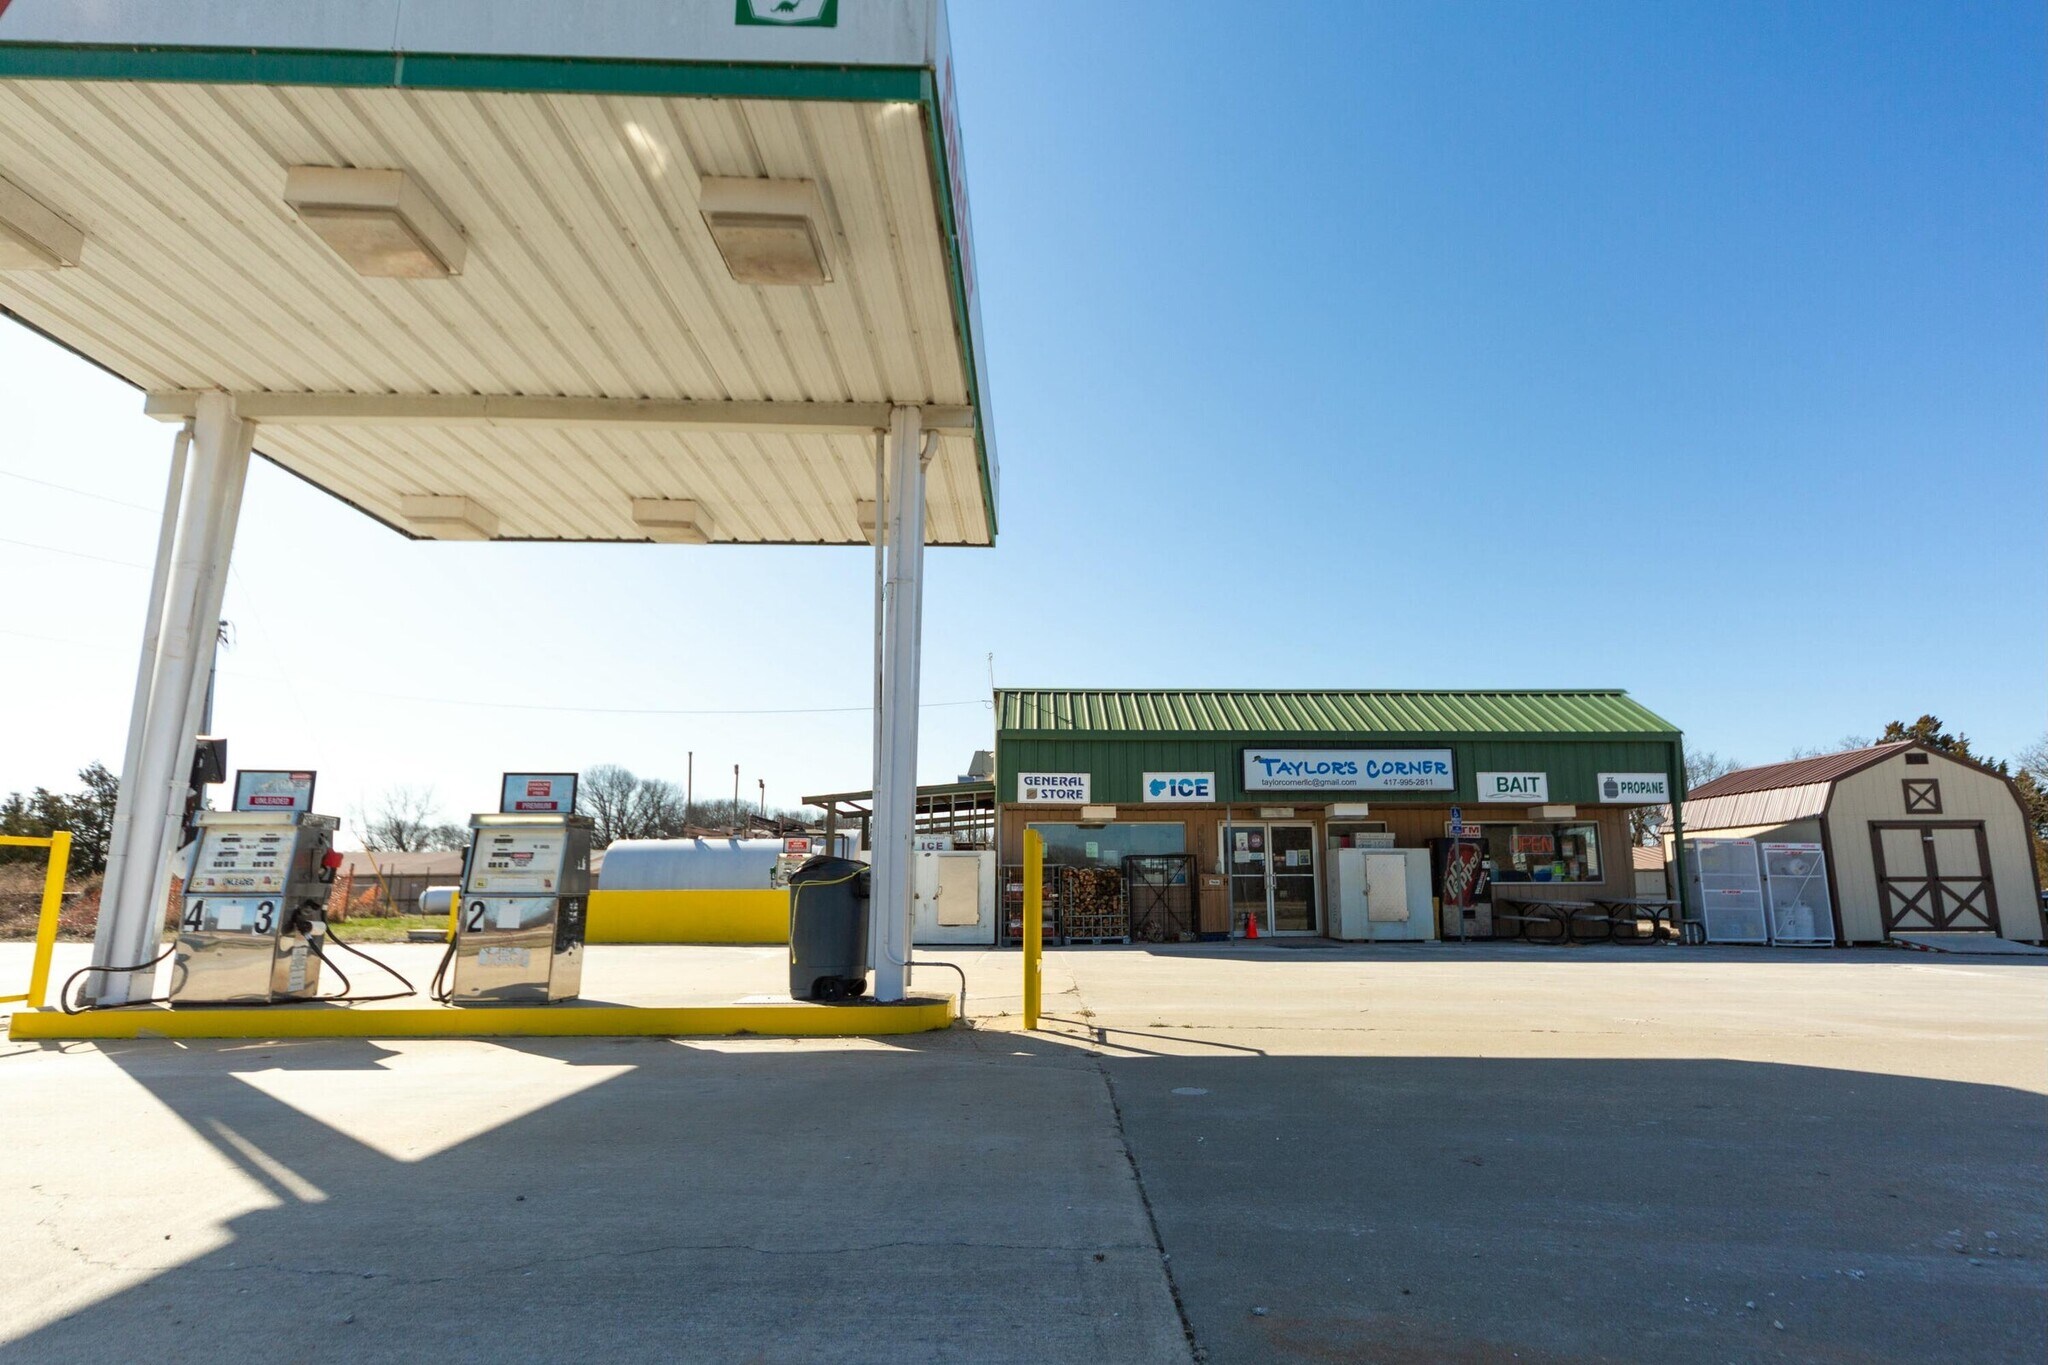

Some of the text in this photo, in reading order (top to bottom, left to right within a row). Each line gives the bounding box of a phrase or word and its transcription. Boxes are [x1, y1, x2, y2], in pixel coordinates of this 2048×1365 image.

[1023, 776, 1084, 786] GENERAL
[1383, 778, 1433, 786] 417-995-2811
[1496, 776, 1540, 793] BAIT
[1168, 778, 1209, 797] ICE
[1620, 781, 1664, 794] PROPANE
[1041, 789, 1083, 799] STORE
[254, 797, 290, 805] UNLEADED
[1461, 826, 1479, 834] TM
[921, 842, 944, 850] ICE
[184, 899, 204, 932] 4
[254, 900, 274, 934] 3
[466, 900, 486, 933] 2
